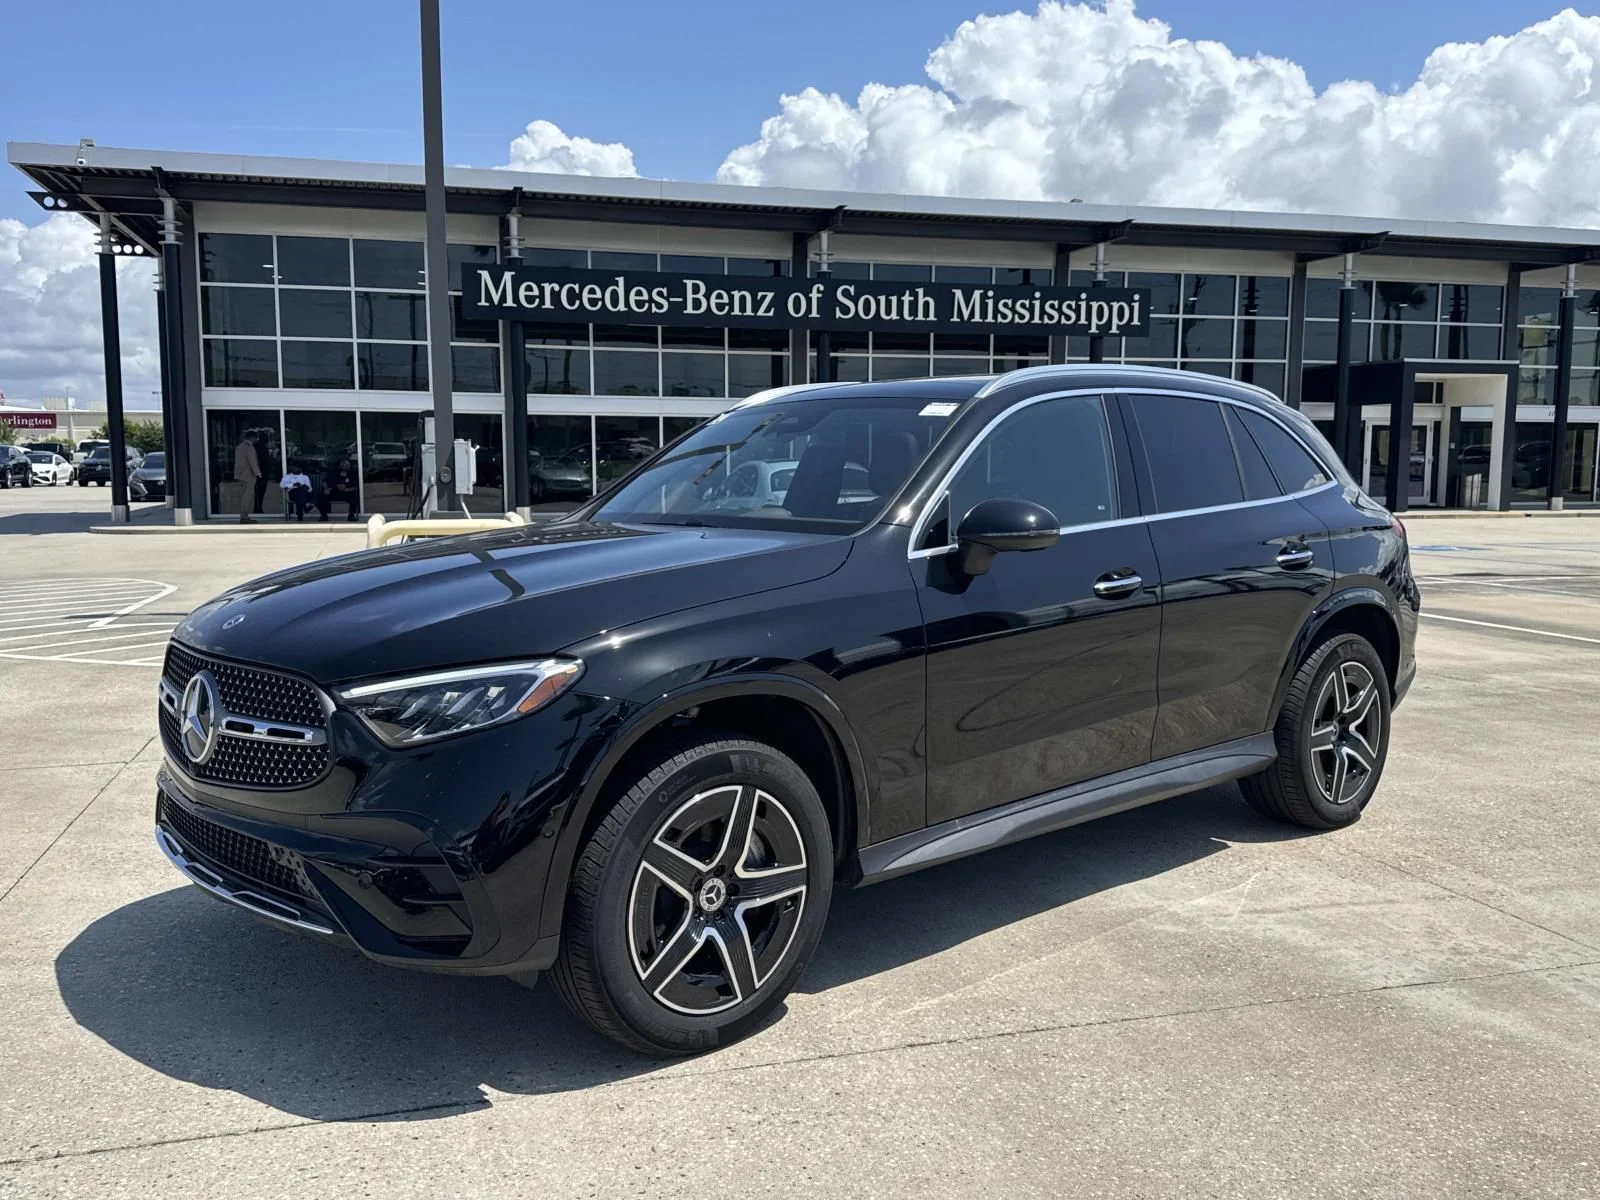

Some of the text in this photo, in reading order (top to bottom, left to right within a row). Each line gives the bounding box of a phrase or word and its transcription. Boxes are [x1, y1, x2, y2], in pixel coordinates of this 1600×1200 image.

[477, 269, 1142, 334] Mercedes-Benz of South Mississippi
[0, 415, 52, 428] rlington
